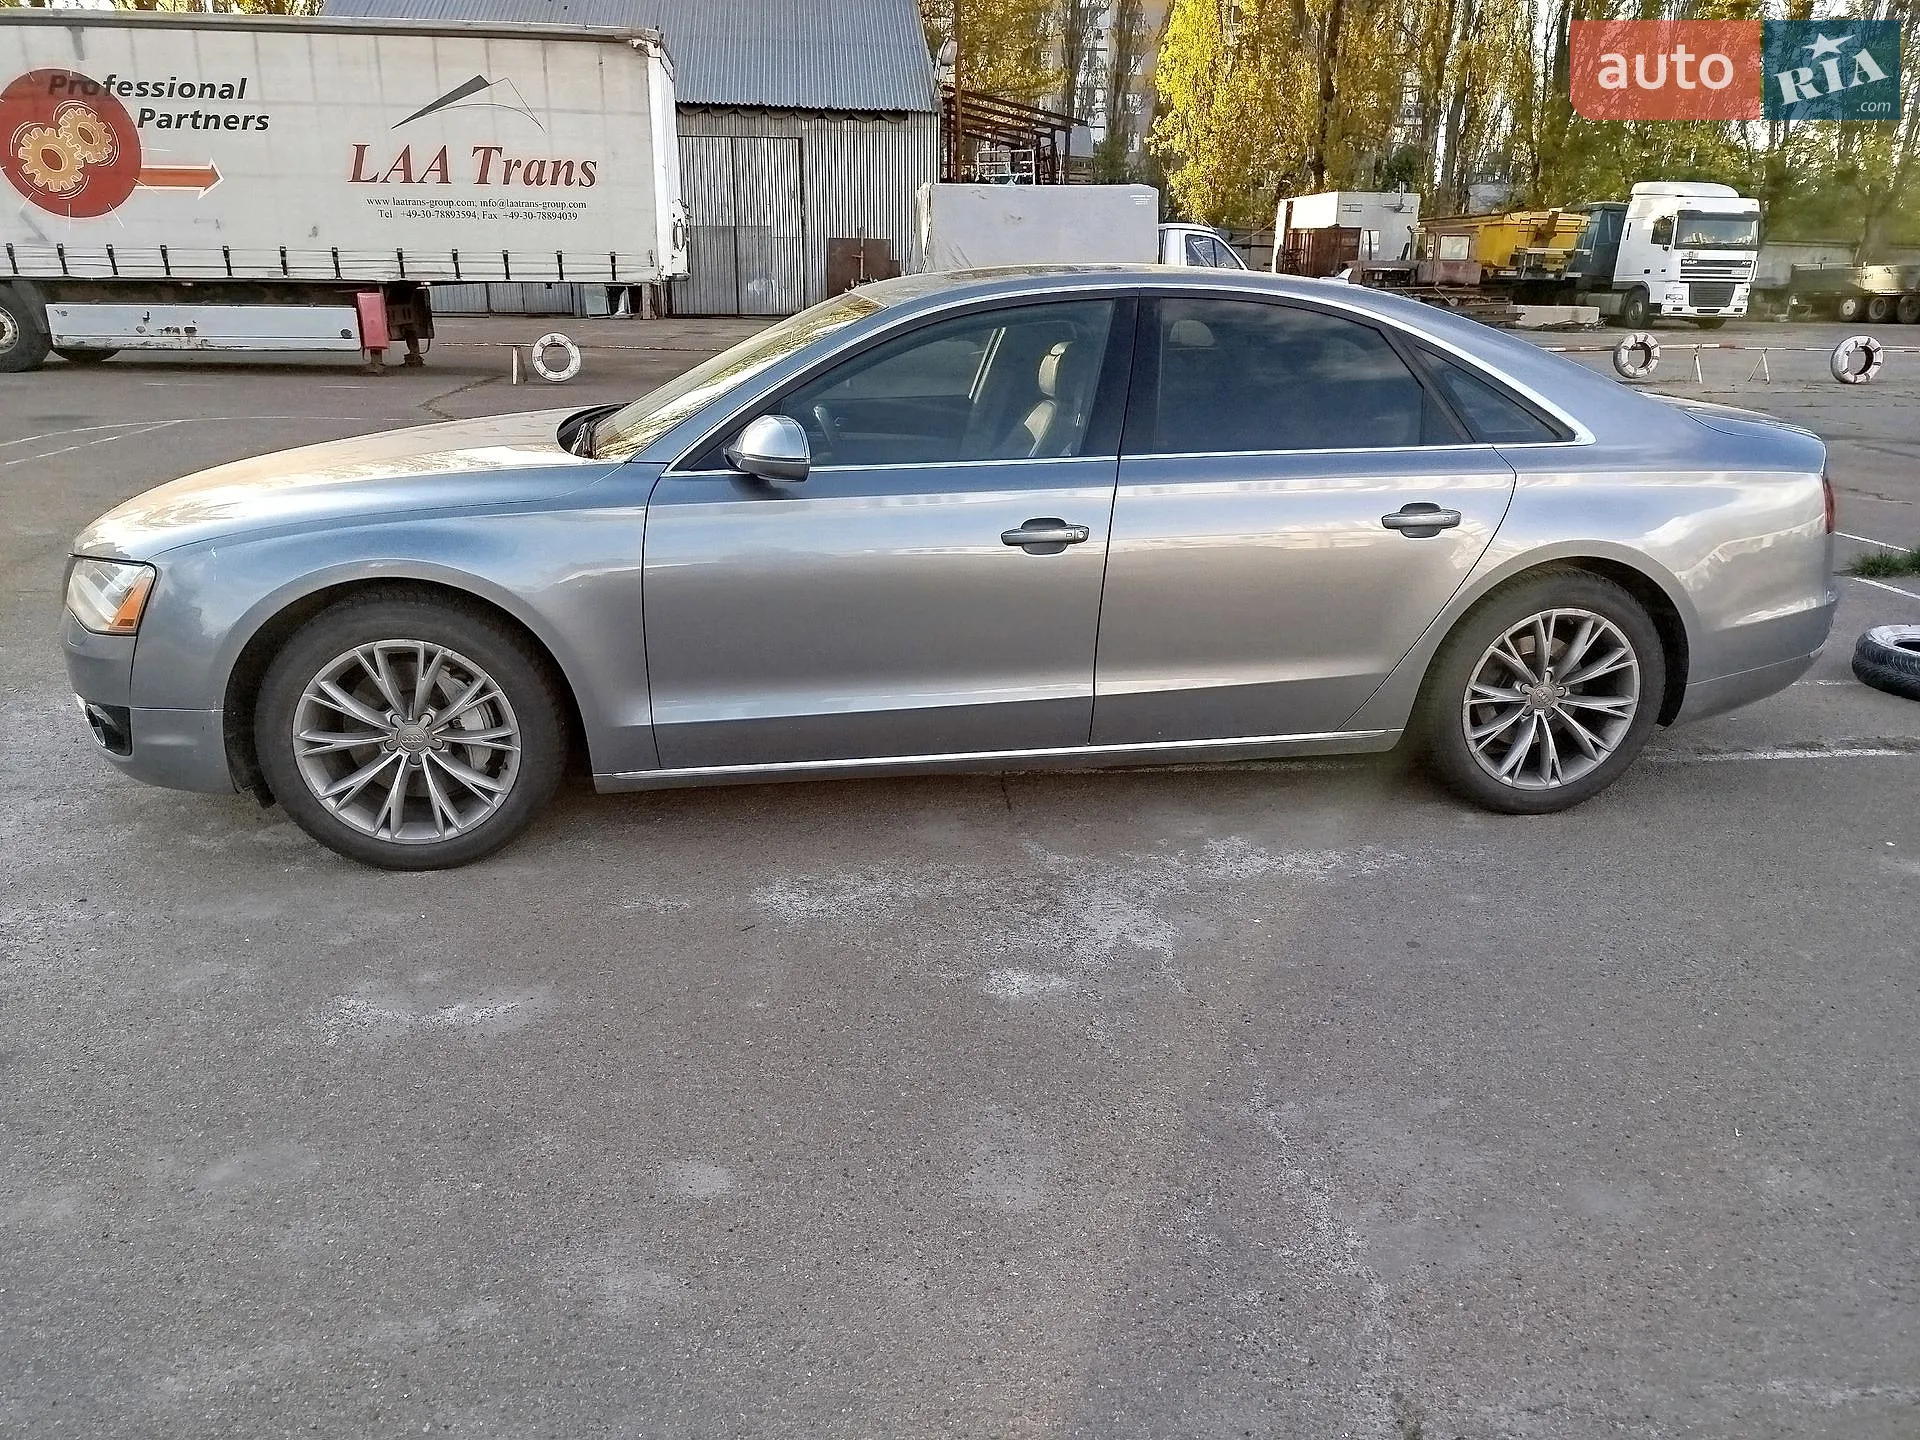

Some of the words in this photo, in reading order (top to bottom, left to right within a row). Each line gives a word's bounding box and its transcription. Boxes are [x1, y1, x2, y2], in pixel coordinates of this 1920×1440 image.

[48, 73, 248, 100] Professional
[137, 107, 270, 131] Partners
[347, 143, 453, 184] LAA
[471, 146, 598, 188] Trans
[366, 197, 478, 209] wwwlaatrans-group.com,
